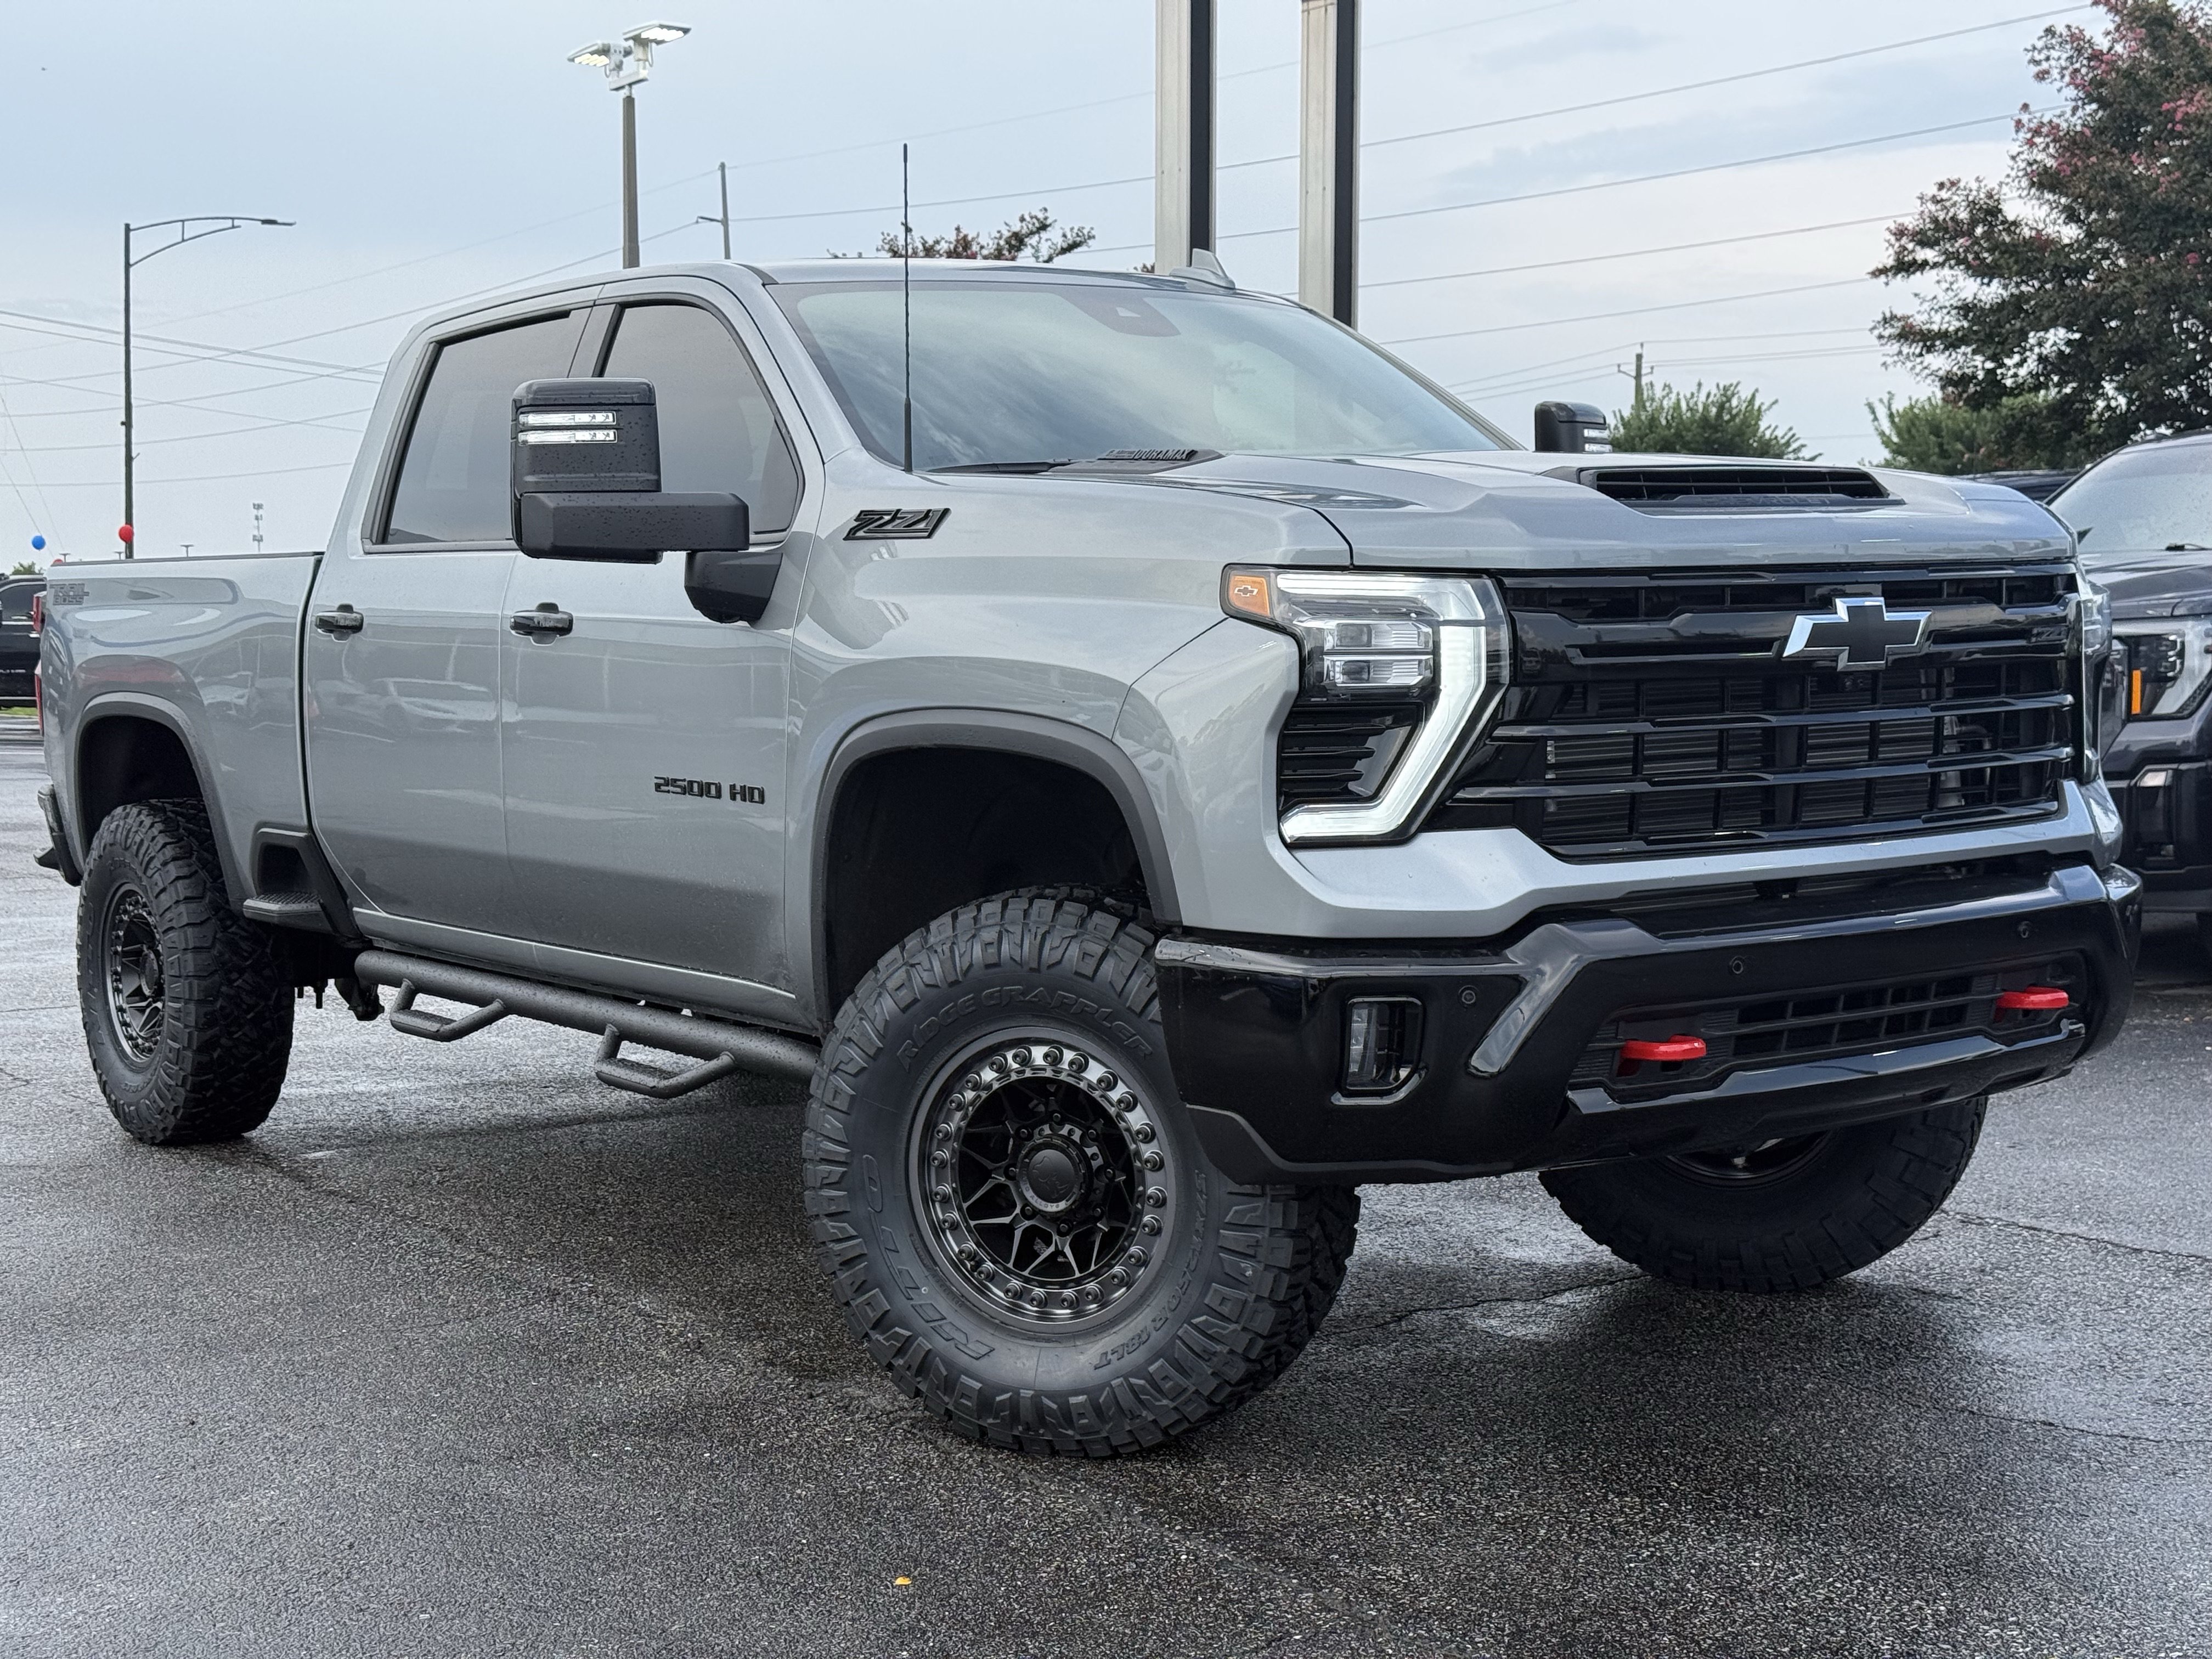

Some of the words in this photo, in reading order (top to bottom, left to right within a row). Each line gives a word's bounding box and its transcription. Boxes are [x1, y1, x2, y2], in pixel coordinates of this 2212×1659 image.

[1133, 448, 1189, 460] DURAMAX
[843, 507, 950, 541] Z71
[49, 583, 90, 596] TRAIL
[53, 596, 84, 605] BOSS
[653, 775, 723, 799] 2500
[729, 783, 766, 805] HD
[896, 992, 978, 1073] RIDGE
[980, 985, 1153, 1061] GRAPPLER
[862, 1154, 996, 1361] NITTO
